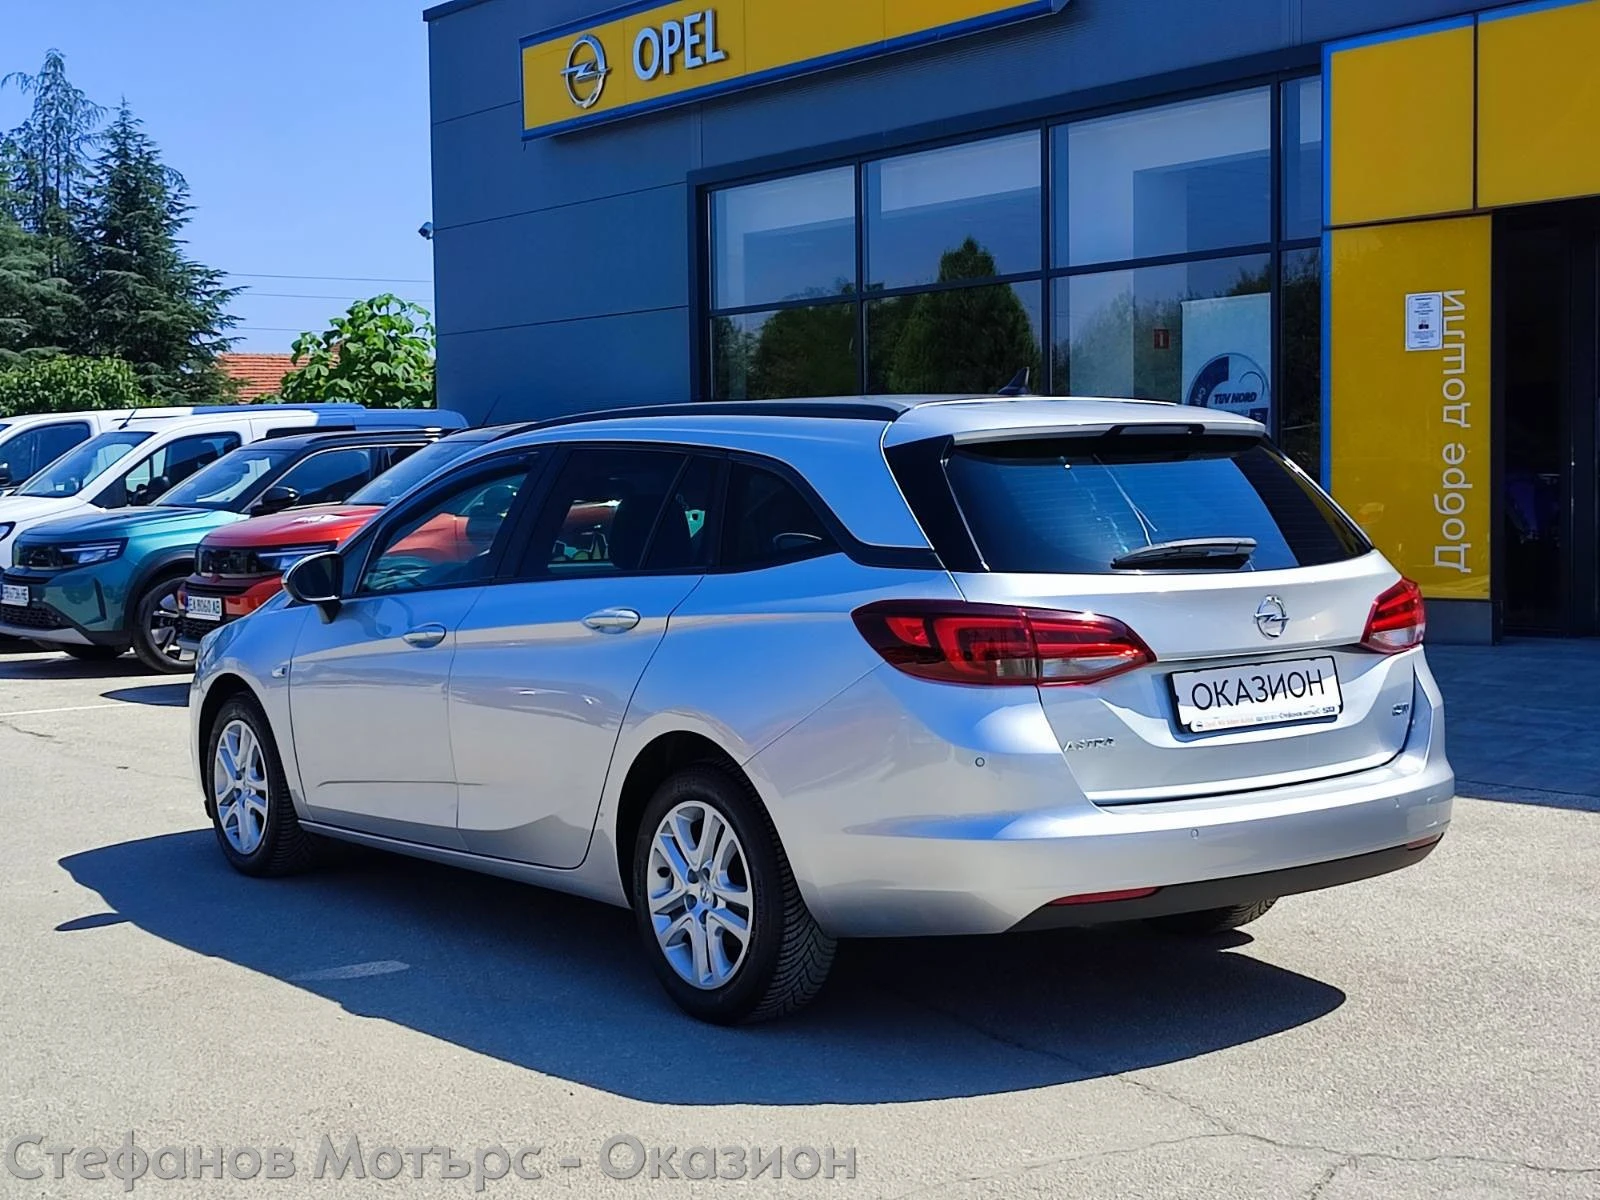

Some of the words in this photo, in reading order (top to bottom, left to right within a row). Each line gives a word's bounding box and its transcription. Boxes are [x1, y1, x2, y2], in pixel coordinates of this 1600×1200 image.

[632, 8, 727, 81] OPEL
[1442, 289, 1471, 428] дошли
[1231, 392, 1257, 403] NORD
[1434, 442, 1473, 573] Добре
[1191, 668, 1325, 711] ОКАЗИОН
